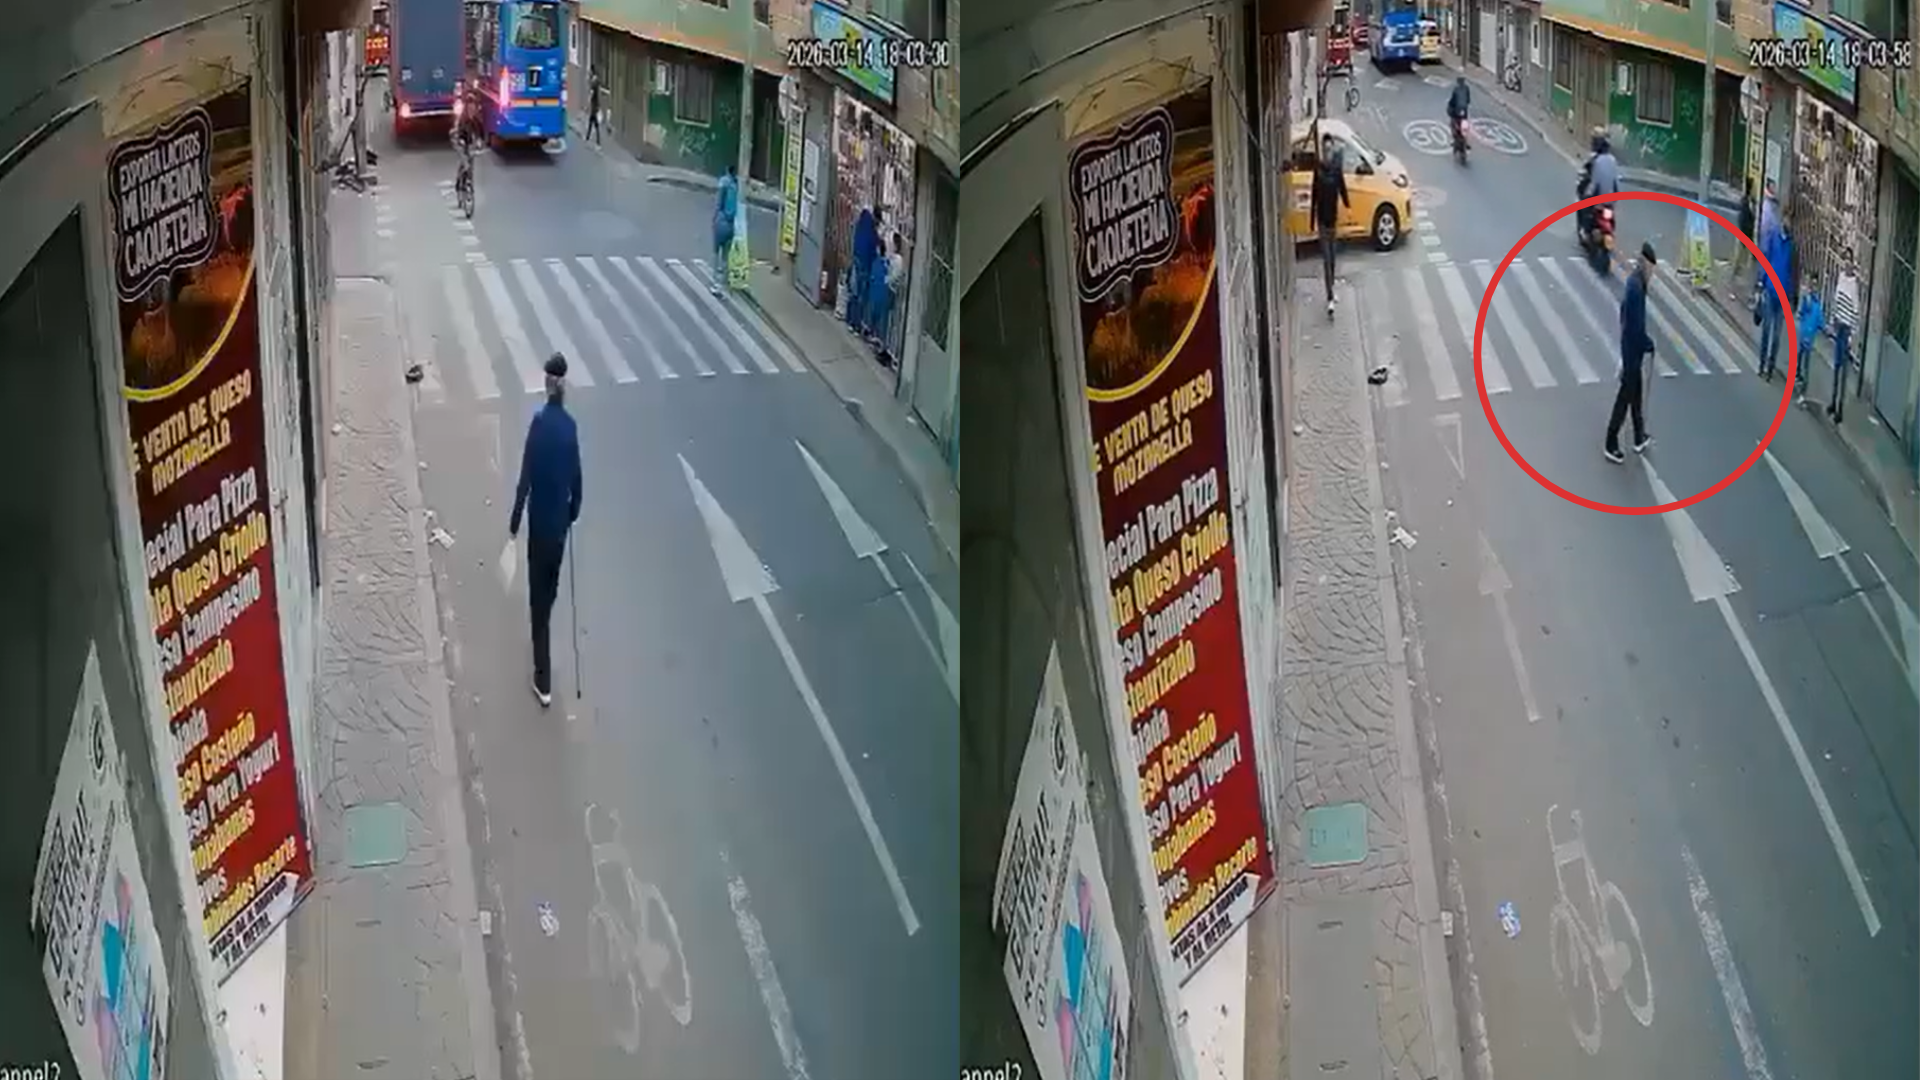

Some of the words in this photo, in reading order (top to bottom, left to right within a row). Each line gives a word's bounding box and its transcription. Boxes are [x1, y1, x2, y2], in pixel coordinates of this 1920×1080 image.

[122, 190, 138, 231] MI
[139, 160, 203, 221] HACIENDA
[1084, 190, 1100, 231] MI
[1101, 160, 1165, 221] HACIENDA
[125, 198, 207, 277] CAQUETEÑA
[1087, 198, 1169, 277] CAQUETEÑA
[143, 411, 188, 463] VENTA
[189, 397, 207, 432] DE
[210, 368, 252, 423] QUESO
[1104, 412, 1149, 464] VENTA
[1150, 398, 1168, 433] DE
[1171, 369, 1213, 424] QUESO
[152, 418, 232, 496] MOZARELLA
[1113, 419, 1193, 497] MOZARELLA
[184, 493, 222, 550] Para
[220, 466, 258, 524] Pizza
[1145, 494, 1183, 551] Para
[1181, 467, 1219, 525] Pizza
[172, 548, 221, 615] Queso
[219, 510, 267, 576] Criollo
[1133, 549, 1182, 616] Queso
[1180, 511, 1228, 577] Criollo
[182, 567, 261, 656] Campesino
[1143, 568, 1222, 657] Campesino
[200, 711, 256, 781] Costeño
[236, 731, 280, 791] Yogurt
[1161, 712, 1217, 782] Costeño
[1197, 732, 1241, 792] Yogurt
